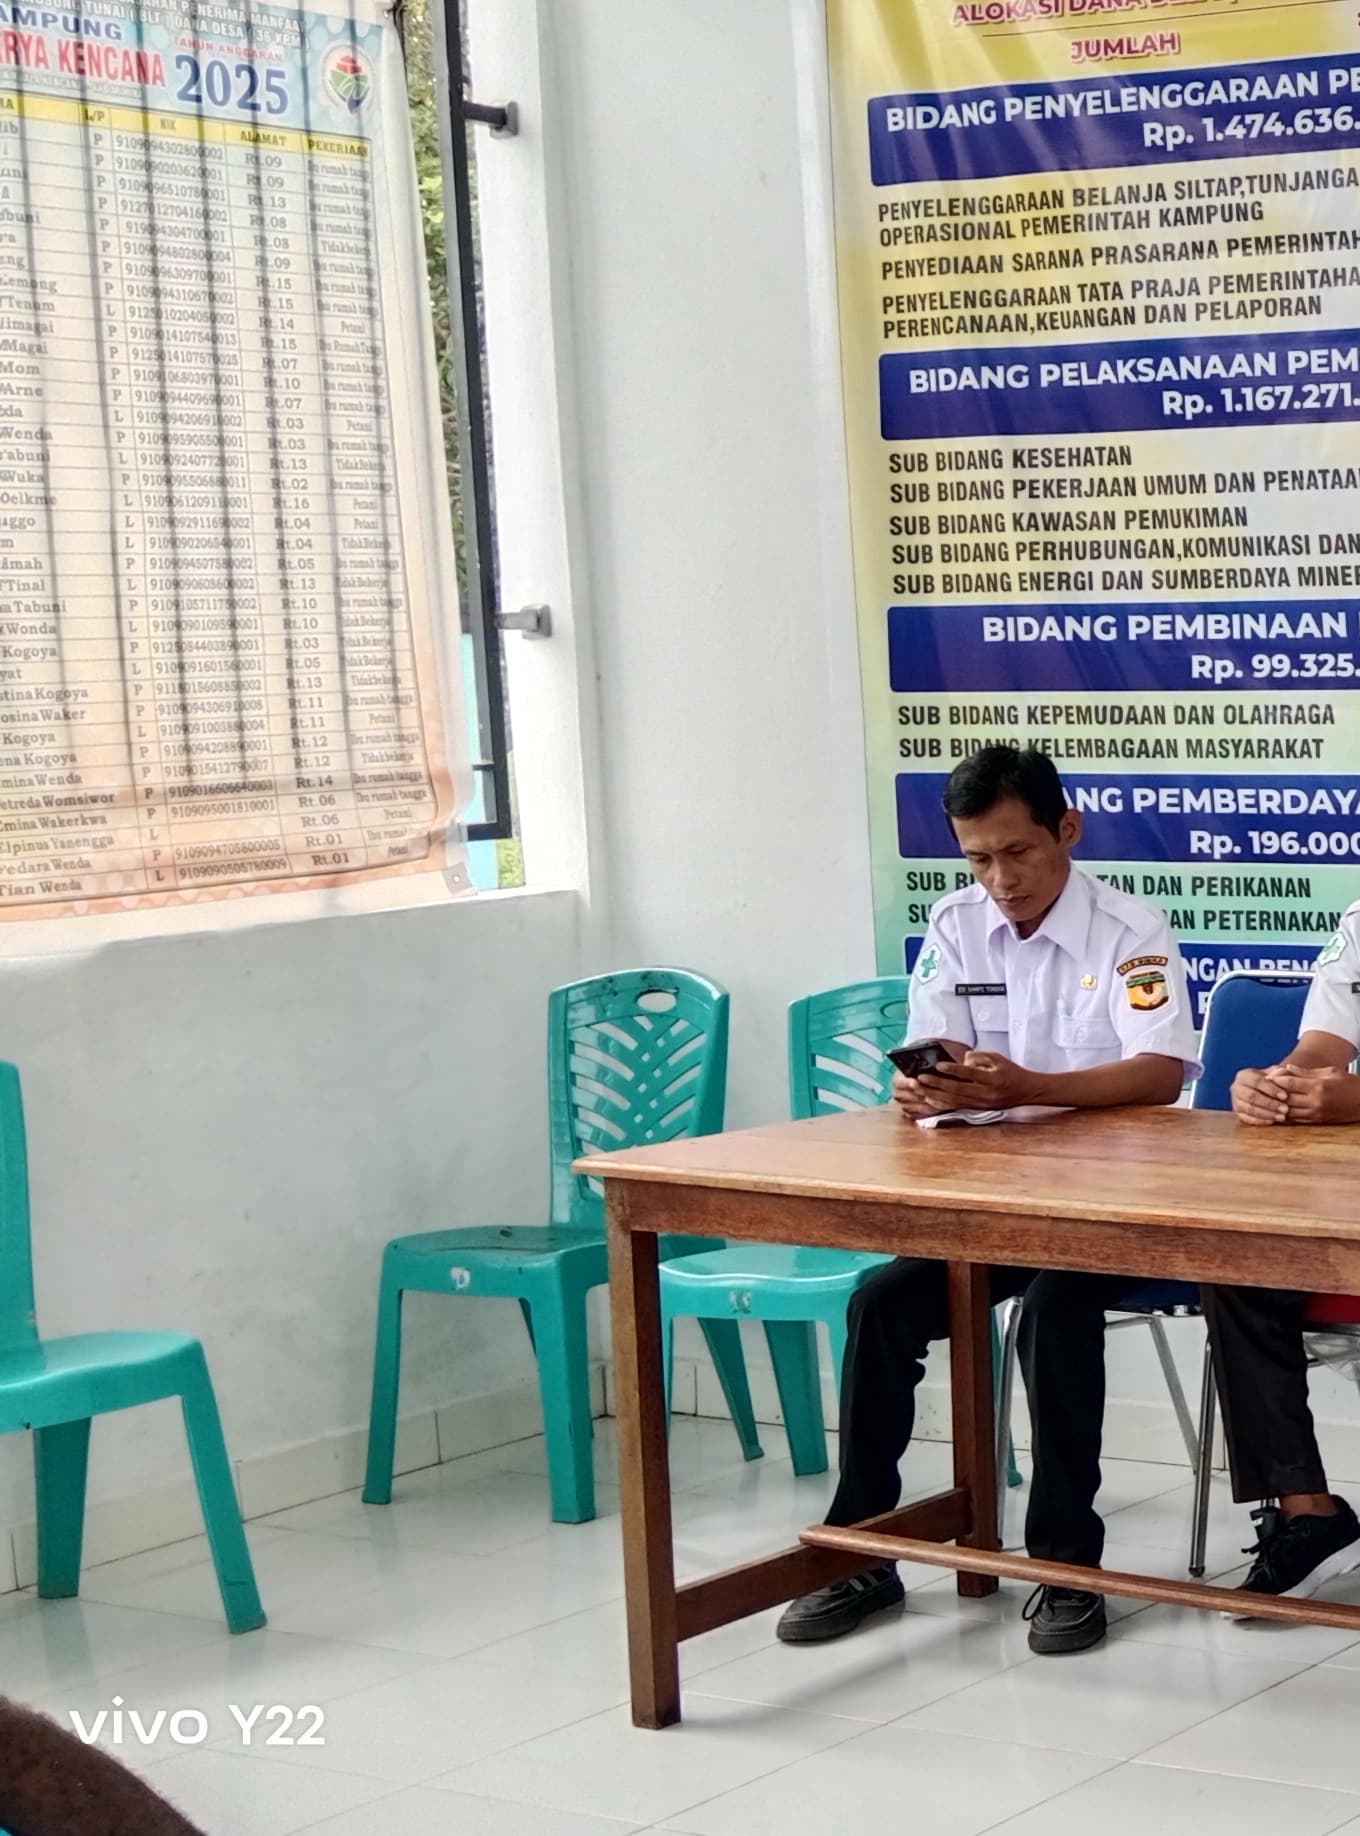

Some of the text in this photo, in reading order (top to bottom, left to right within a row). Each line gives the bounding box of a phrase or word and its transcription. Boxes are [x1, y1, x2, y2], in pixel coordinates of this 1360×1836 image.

[0, 5, 122, 40] AMPUNG
[953, 0, 1064, 24] ALOKASI
[0, 29, 50, 70] RYA
[58, 38, 166, 87] KENCANA
[1072, 33, 1180, 61] JUMLAH
[175, 53, 289, 116] 2025
[887, 102, 997, 132] BIDANG
[1005, 72, 1319, 123] PENYELENGGARAAN
[1144, 121, 1194, 151] Rp.
[878, 189, 1065, 222] PENYELENGGARAAN
[1073, 181, 1167, 208] BELANJA
[880, 202, 1264, 247] OPERASIONAL PEMERINTAH KAMPUNG
[882, 254, 1004, 281] PENYEDIAAN
[1012, 248, 1084, 272] SARANA
[1092, 240, 1219, 267] PRASARANA
[883, 285, 1072, 315] PENYELENGGARAAN
[1078, 282, 1124, 304] TATA
[1131, 275, 1200, 300] PRAJA
[883, 295, 1323, 339] PERENCANAAN,KEUANGAN DAN PELAPORAN
[909, 365, 1030, 394] BIDANG
[1040, 350, 1278, 388] PELAKSANAAN
[1163, 390, 1213, 420] Rp.
[889, 445, 1132, 474] SUB BIDANG KESEHATAN
[890, 483, 930, 504] SUB
[937, 480, 1005, 501] BIDANG
[1013, 477, 1137, 499] PEKERJAAN
[1143, 474, 1207, 496] UMUM
[1214, 472, 1256, 494] DAN
[890, 507, 1248, 536] SUB BIDANG KAWASAN PEMUKIMAN
[892, 545, 933, 565] SUB
[940, 542, 1009, 564] BIDANG
[1016, 535, 1312, 563] PERHUBUNGAN,KOMUNIKASI
[893, 575, 935, 595] SUB
[942, 573, 1012, 594] BIDANG
[1018, 571, 1094, 592] ENERGI
[1101, 569, 1143, 591] DAN
[1151, 568, 1290, 591] SUMBERDAYA
[983, 615, 1117, 642] BIDANG
[1128, 612, 1348, 641] PEMBINAAN
[1191, 655, 1243, 685] Rp.
[898, 703, 1335, 726] SUB BIDANG KEPEMUDAAN DAN OLAHRAGA
[899, 738, 942, 758] SUB
[1027, 738, 1179, 759] KELEMBAGAAN
[1186, 738, 1324, 760] MASYARAKAT
[1190, 830, 1241, 860] Rp.
[906, 872, 947, 893] SUB
[1144, 876, 1183, 897] DAN
[1191, 876, 1312, 898] PERIKANAN
[908, 904, 1342, 932] SU AN PETERNAKAN
